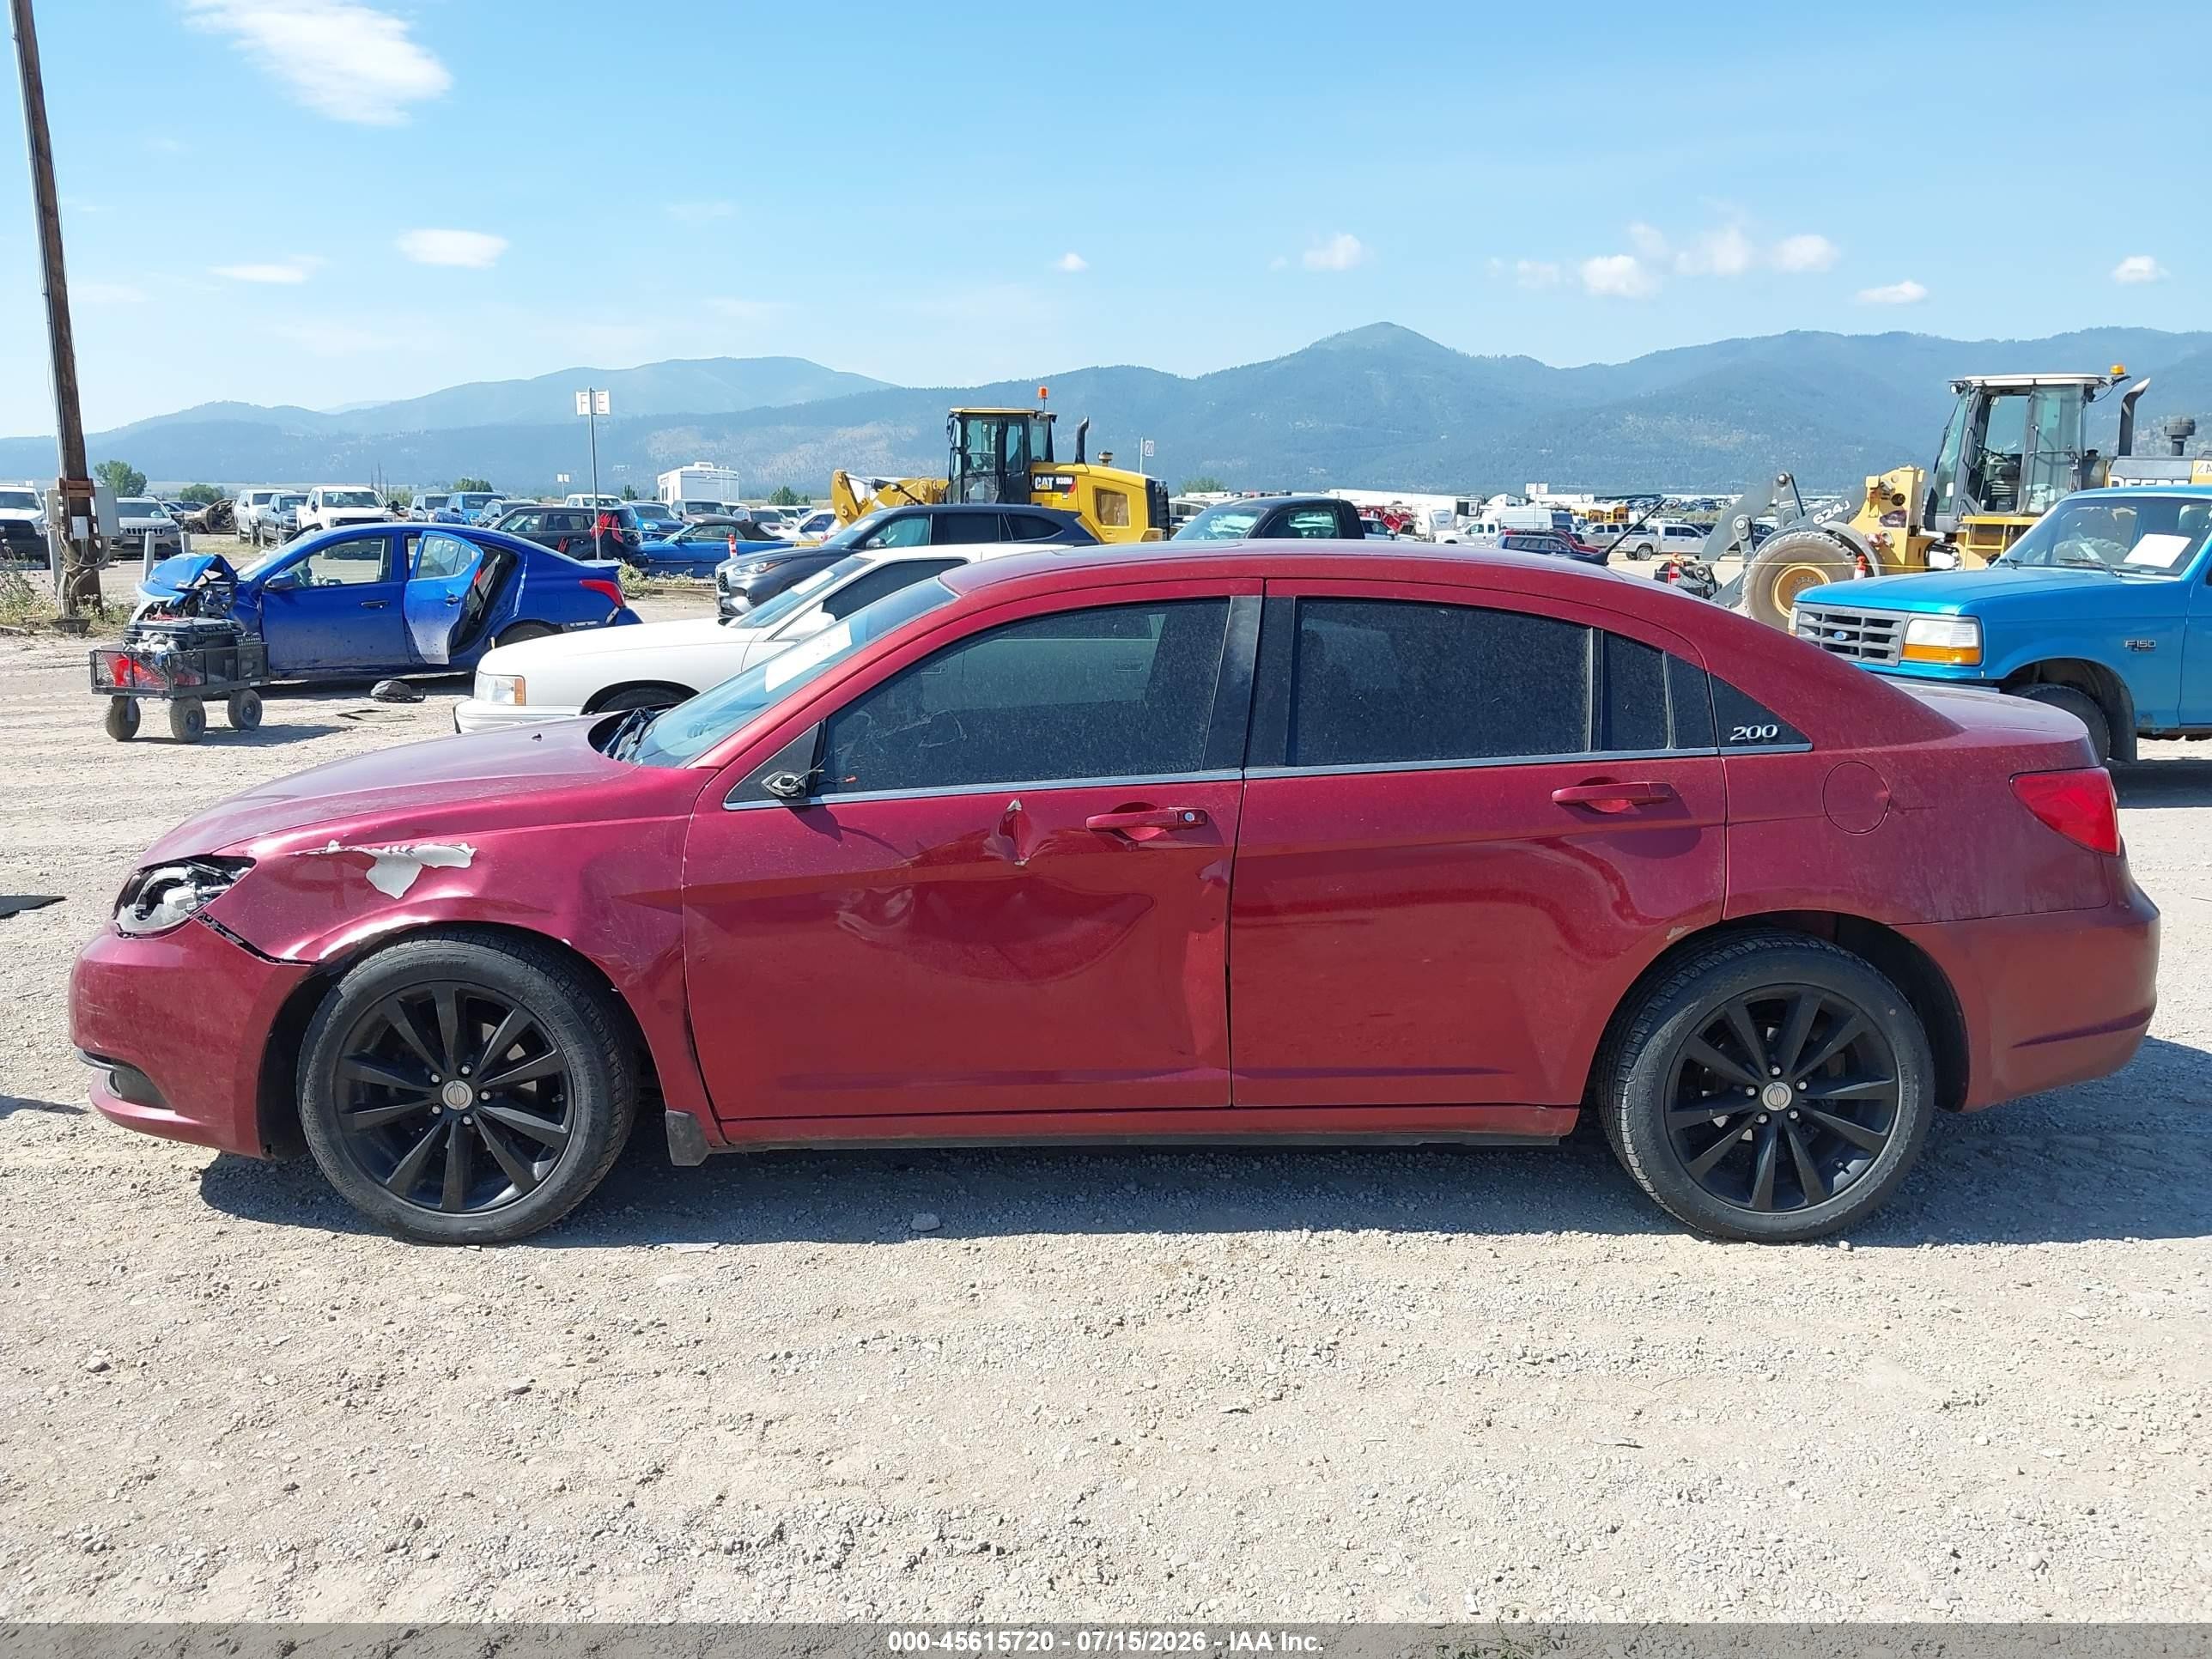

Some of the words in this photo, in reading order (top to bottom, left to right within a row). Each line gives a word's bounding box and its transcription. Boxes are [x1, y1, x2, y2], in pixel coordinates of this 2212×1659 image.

[580, 393, 588, 413] F
[597, 393, 605, 412] E
[1035, 477, 1054, 489] CAT
[1813, 500, 1850, 525] 624J
[1730, 725, 1778, 742] 200
